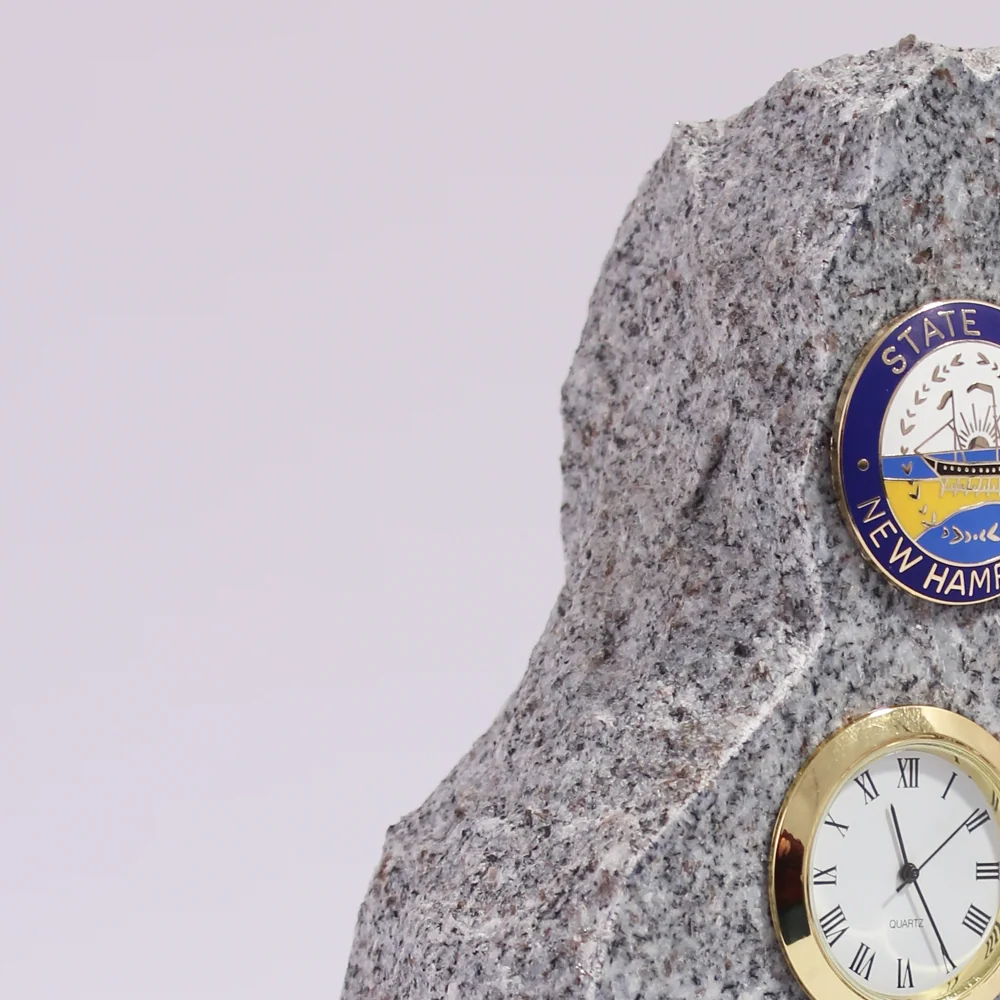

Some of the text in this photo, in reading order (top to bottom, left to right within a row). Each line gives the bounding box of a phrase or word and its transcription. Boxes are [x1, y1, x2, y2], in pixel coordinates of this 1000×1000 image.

[881, 308, 981, 375] STATE
[857, 496, 923, 574] NEW
[854, 770, 881, 805] XI
[897, 757, 920, 789] XII
[824, 813, 849, 837] X
[813, 865, 837, 886] IX
[976, 861, 1000, 881] III
[889, 918, 924, 930] QUARTZ
[849, 942, 876, 981] VII
[897, 958, 914, 989] VI
